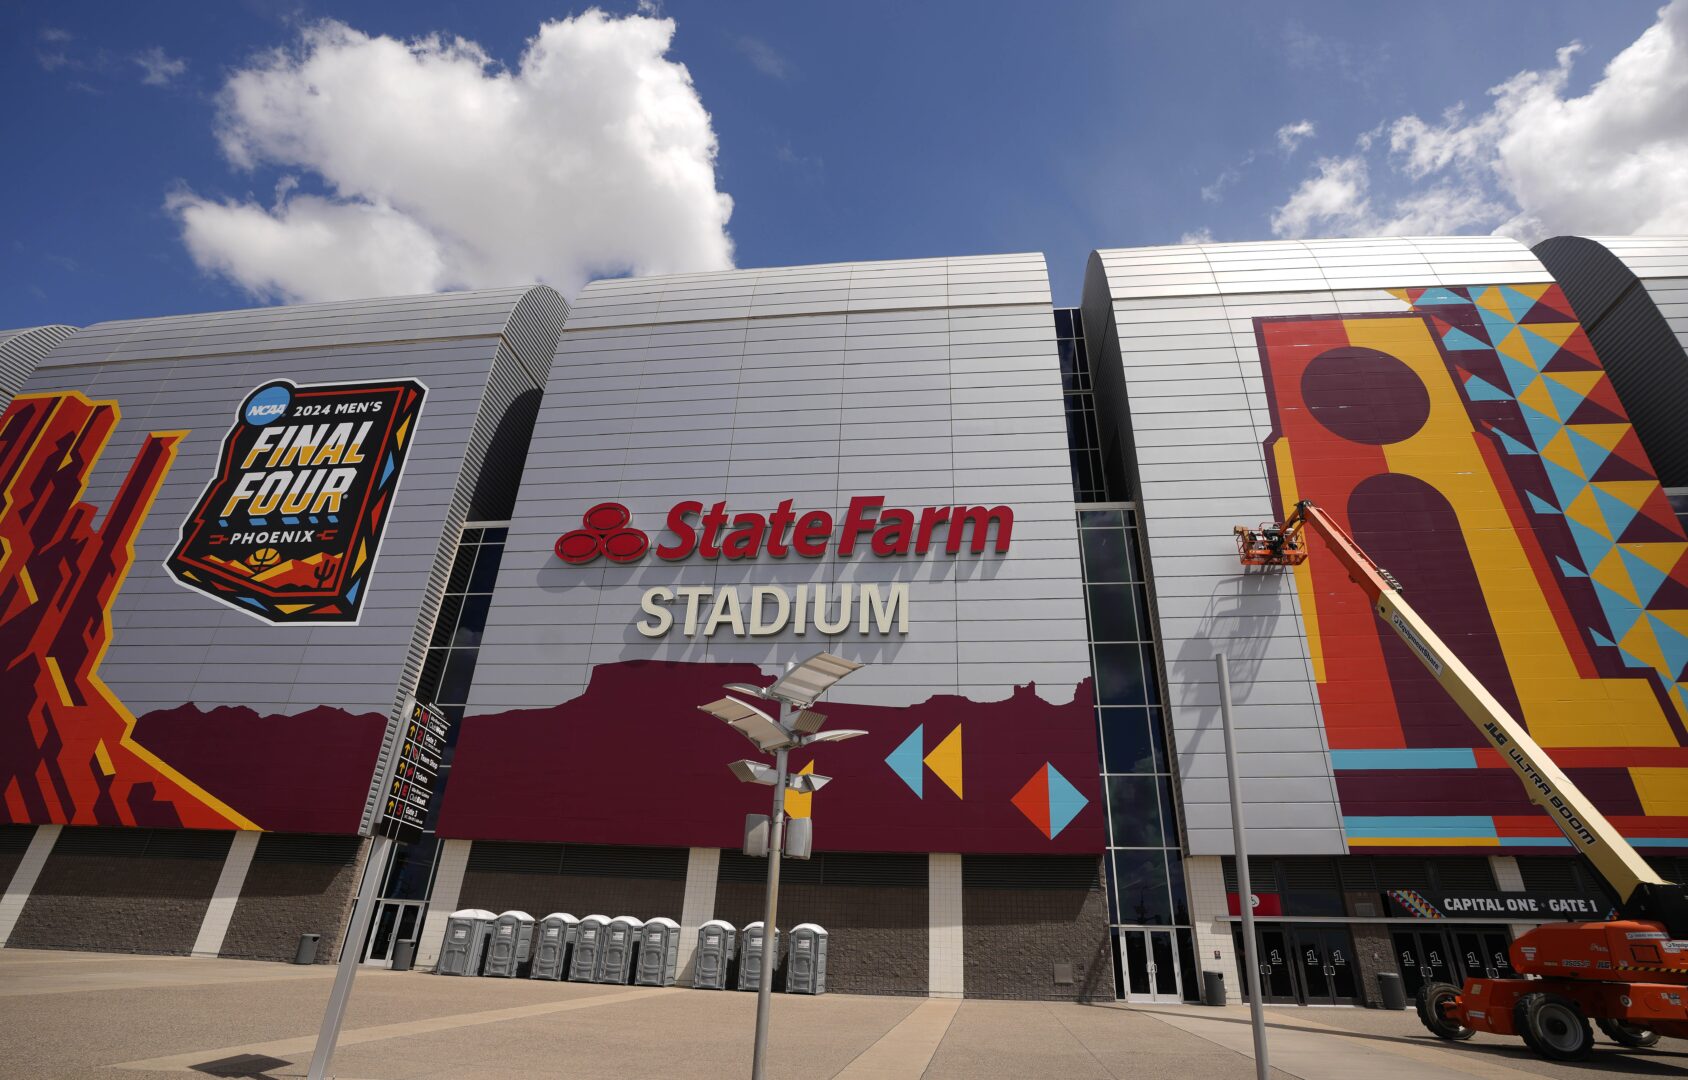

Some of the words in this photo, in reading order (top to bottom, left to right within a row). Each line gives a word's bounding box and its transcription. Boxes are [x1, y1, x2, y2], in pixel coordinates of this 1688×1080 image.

[247, 404, 286, 417] NCAA
[293, 404, 331, 417] 2024
[334, 401, 383, 415] MEN'S
[241, 420, 374, 469] FINAL
[220, 467, 358, 517] FOUR
[229, 530, 315, 545] PHOENIX
[636, 582, 909, 638] STADIUM
[1398, 618, 1439, 670] EquipmentShare
[416, 729, 424, 742] 2
[415, 771, 428, 784] Tickets
[1483, 722, 1508, 746] JLG
[1509, 748, 1552, 796] ULTRA
[1550, 795, 1596, 845] BOOM
[396, 803, 403, 816] 3
[405, 806, 415, 816] Gate
[1443, 898, 1504, 911] CAPITAL
[1507, 898, 1539, 912] ONE
[1549, 899, 1588, 912] GATE
[1590, 899, 1598, 913] 1
[1271, 949, 1282, 963] 1
[1306, 949, 1318, 963] 1
[1333, 949, 1345, 963] 1
[1402, 950, 1415, 964] 1
[1430, 951, 1442, 964] 1
[1467, 951, 1480, 965] 1
[1495, 952, 1507, 966] 1
